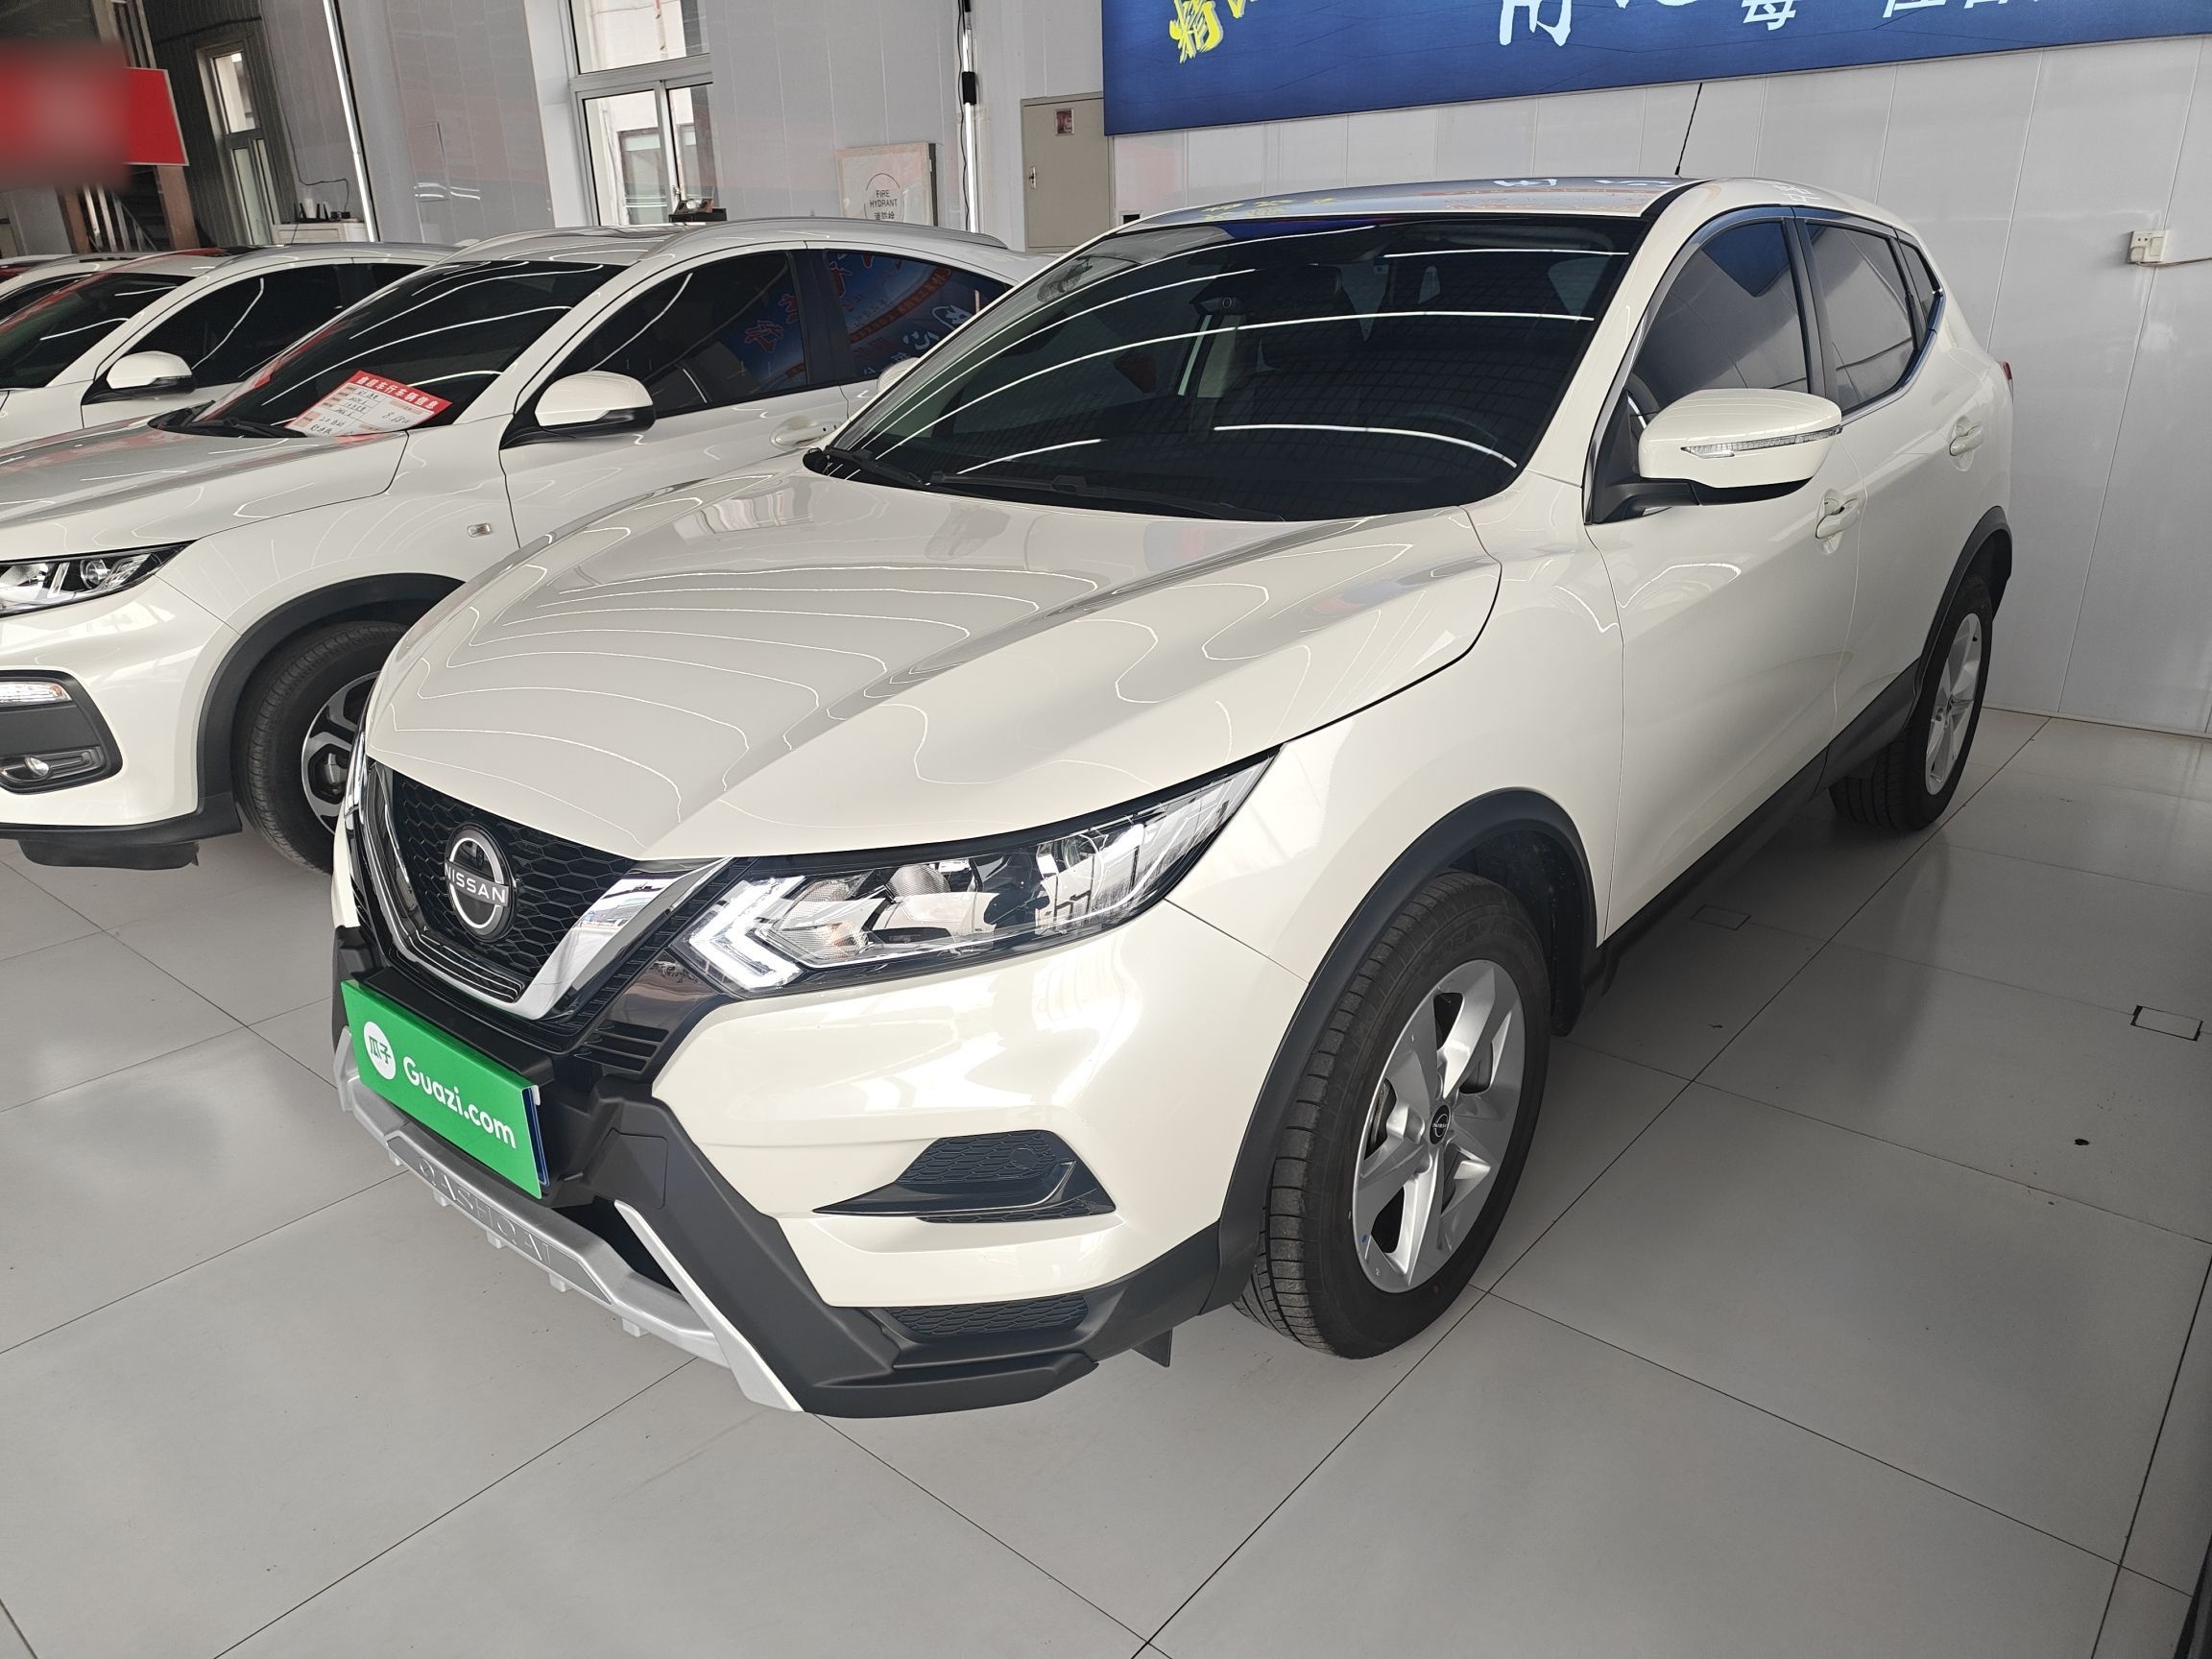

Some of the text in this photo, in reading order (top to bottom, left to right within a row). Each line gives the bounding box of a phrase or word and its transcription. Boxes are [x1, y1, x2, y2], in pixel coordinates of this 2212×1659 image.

[869, 198, 898, 208] HYDRANT
[876, 189, 890, 198] FIRE
[445, 863, 506, 903] NISSAN
[369, 1035, 392, 1065] 瓜子
[403, 1056, 517, 1149] Guazi.com
